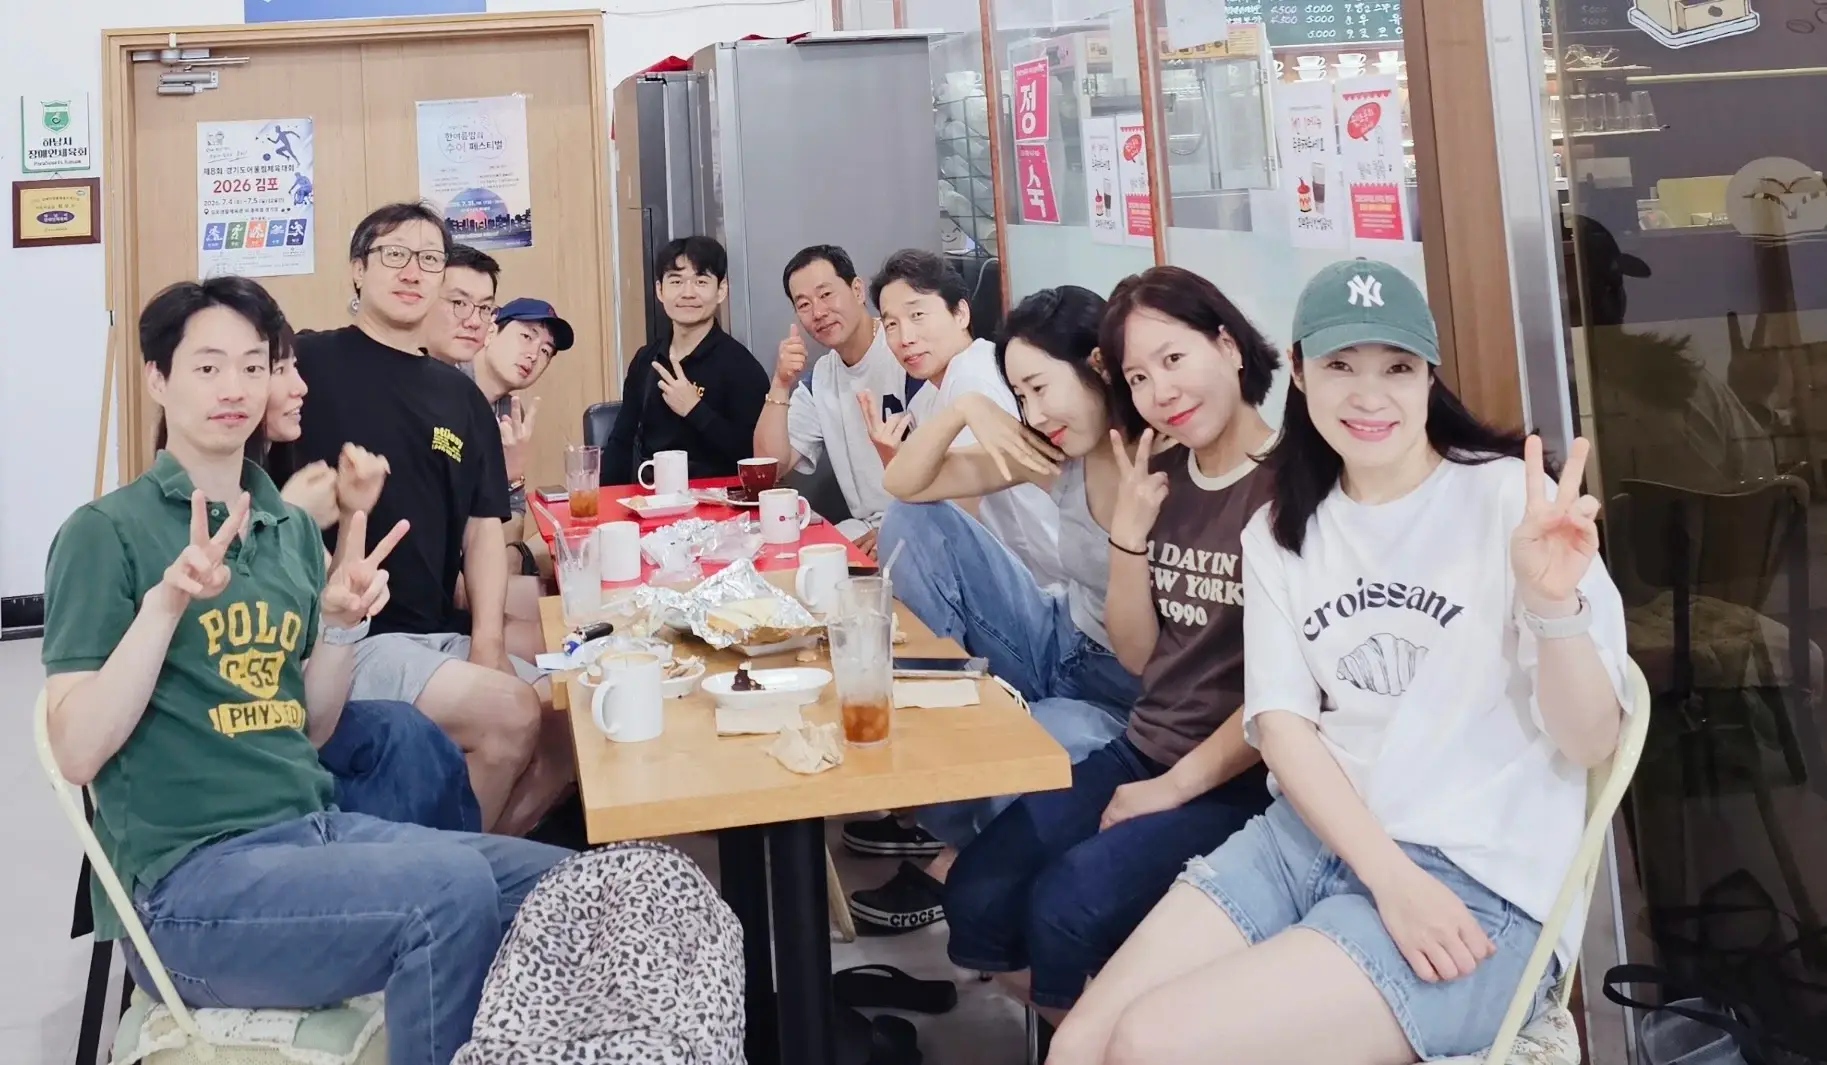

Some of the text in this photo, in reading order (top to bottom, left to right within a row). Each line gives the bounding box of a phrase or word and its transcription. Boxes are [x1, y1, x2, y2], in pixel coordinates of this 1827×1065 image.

[1020, 80, 1036, 134] 정
[28, 147, 88, 160] 장애인체육회
[42, 136, 72, 147] 하남시
[469, 140, 503, 150] 페스티벌
[203, 167, 223, 175] 제8회
[213, 177, 279, 194] 2026 김포
[1027, 164, 1047, 218] 숙
[1347, 274, 1385, 307] NY
[1185, 573, 1244, 607] YORK
[1158, 598, 1208, 627] 1990
[1303, 577, 1465, 642] croissant
[198, 601, 301, 656] POLO
[890, 909, 934, 927] crocs
